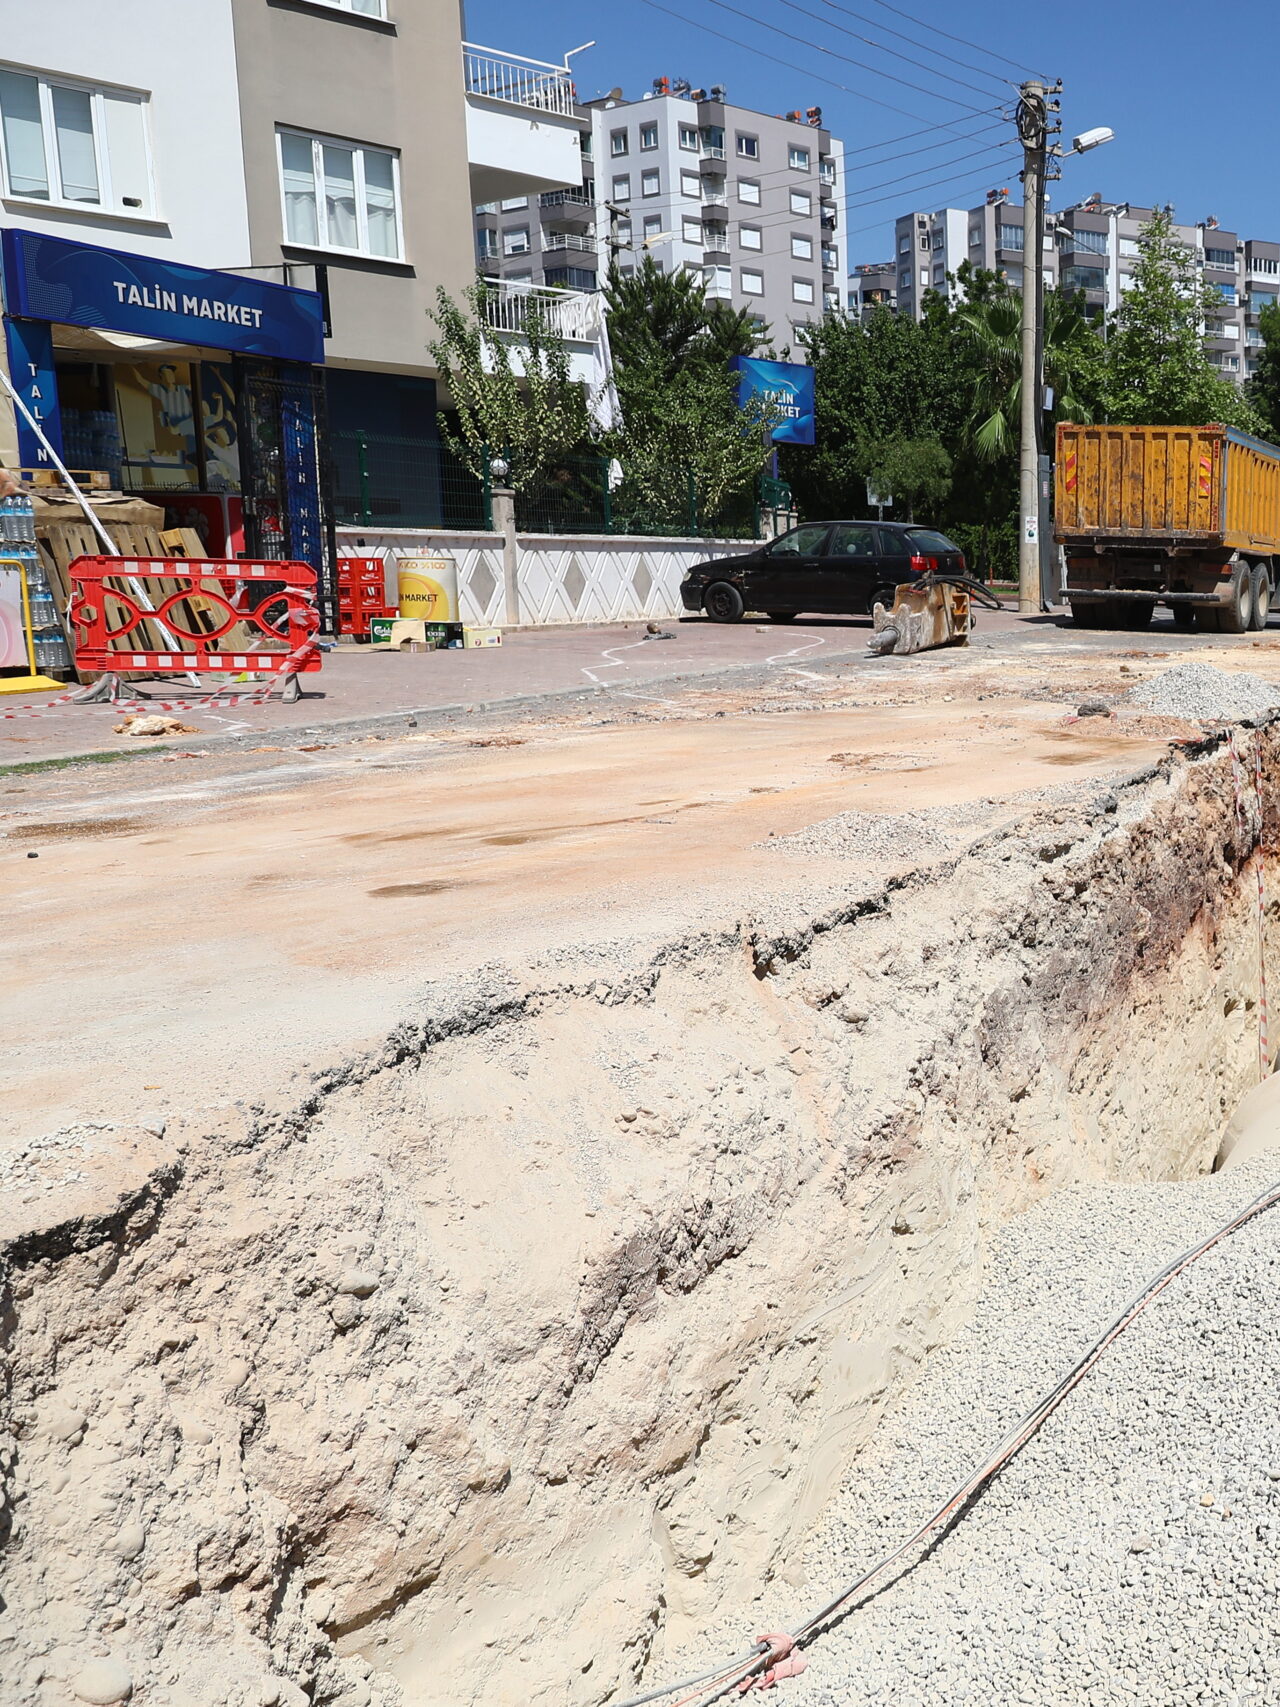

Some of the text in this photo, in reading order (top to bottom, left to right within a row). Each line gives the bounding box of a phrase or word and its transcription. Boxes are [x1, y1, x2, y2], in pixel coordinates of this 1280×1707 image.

[113, 281, 263, 328] TALİN MARKET
[300, 507, 310, 556] MAR
[405, 593, 438, 602] MARKET
